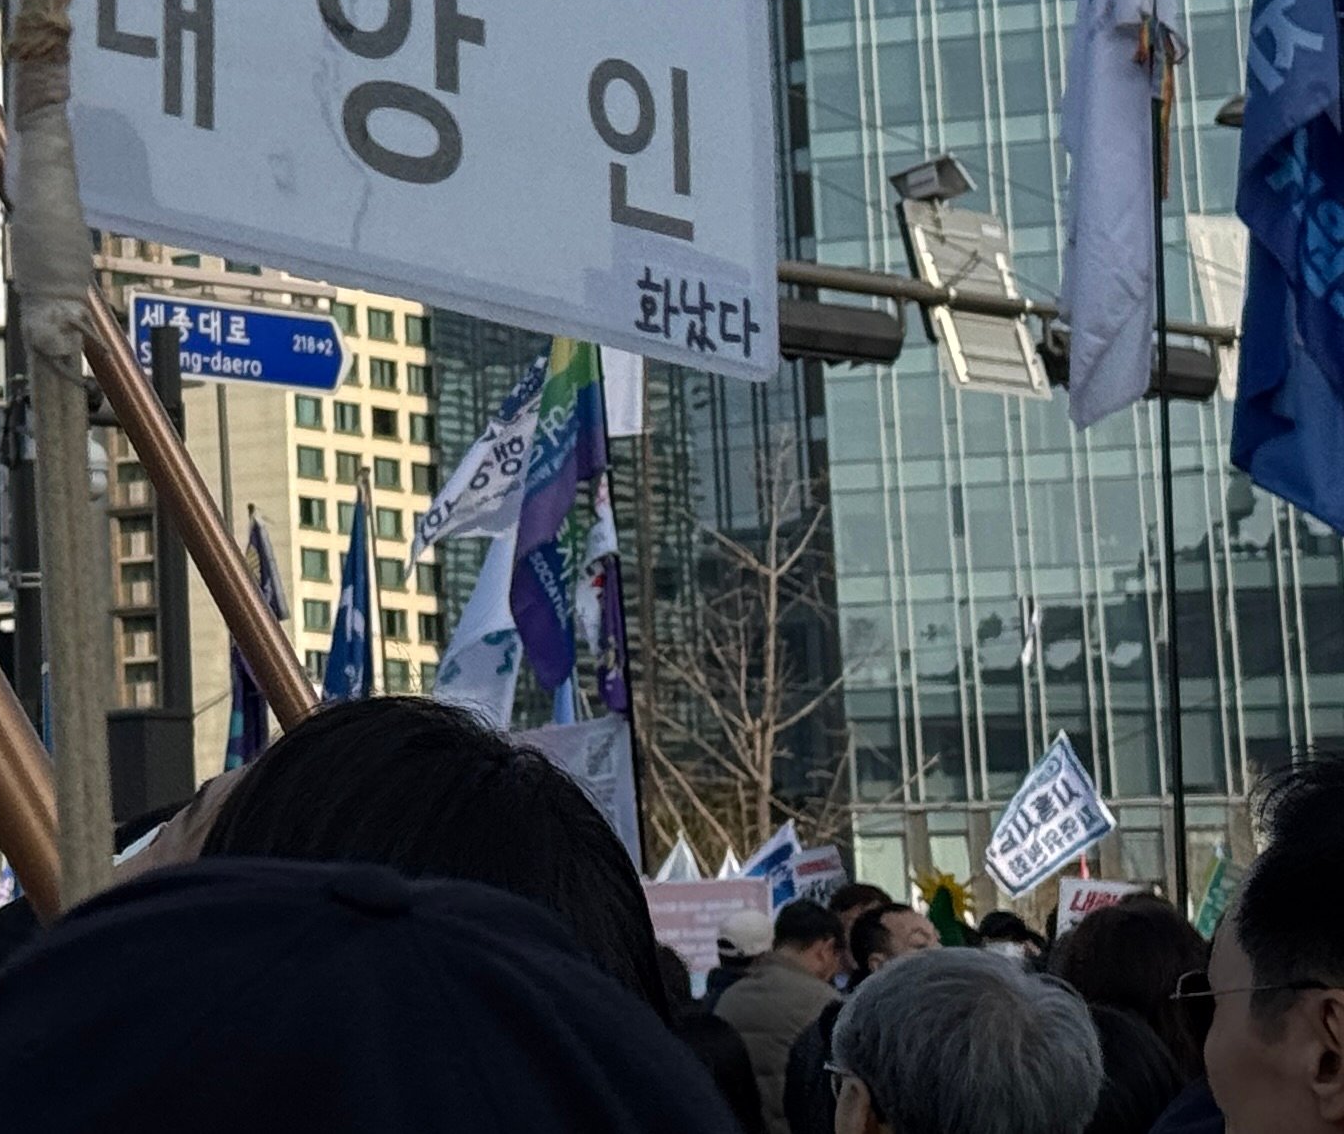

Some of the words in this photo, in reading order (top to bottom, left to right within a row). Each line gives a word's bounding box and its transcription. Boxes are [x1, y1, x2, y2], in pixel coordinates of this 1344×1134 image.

[140, 303, 251, 345] 세종대로
[634, 266, 761, 358] 화났다
[140, 341, 263, 377] Sng-daero
